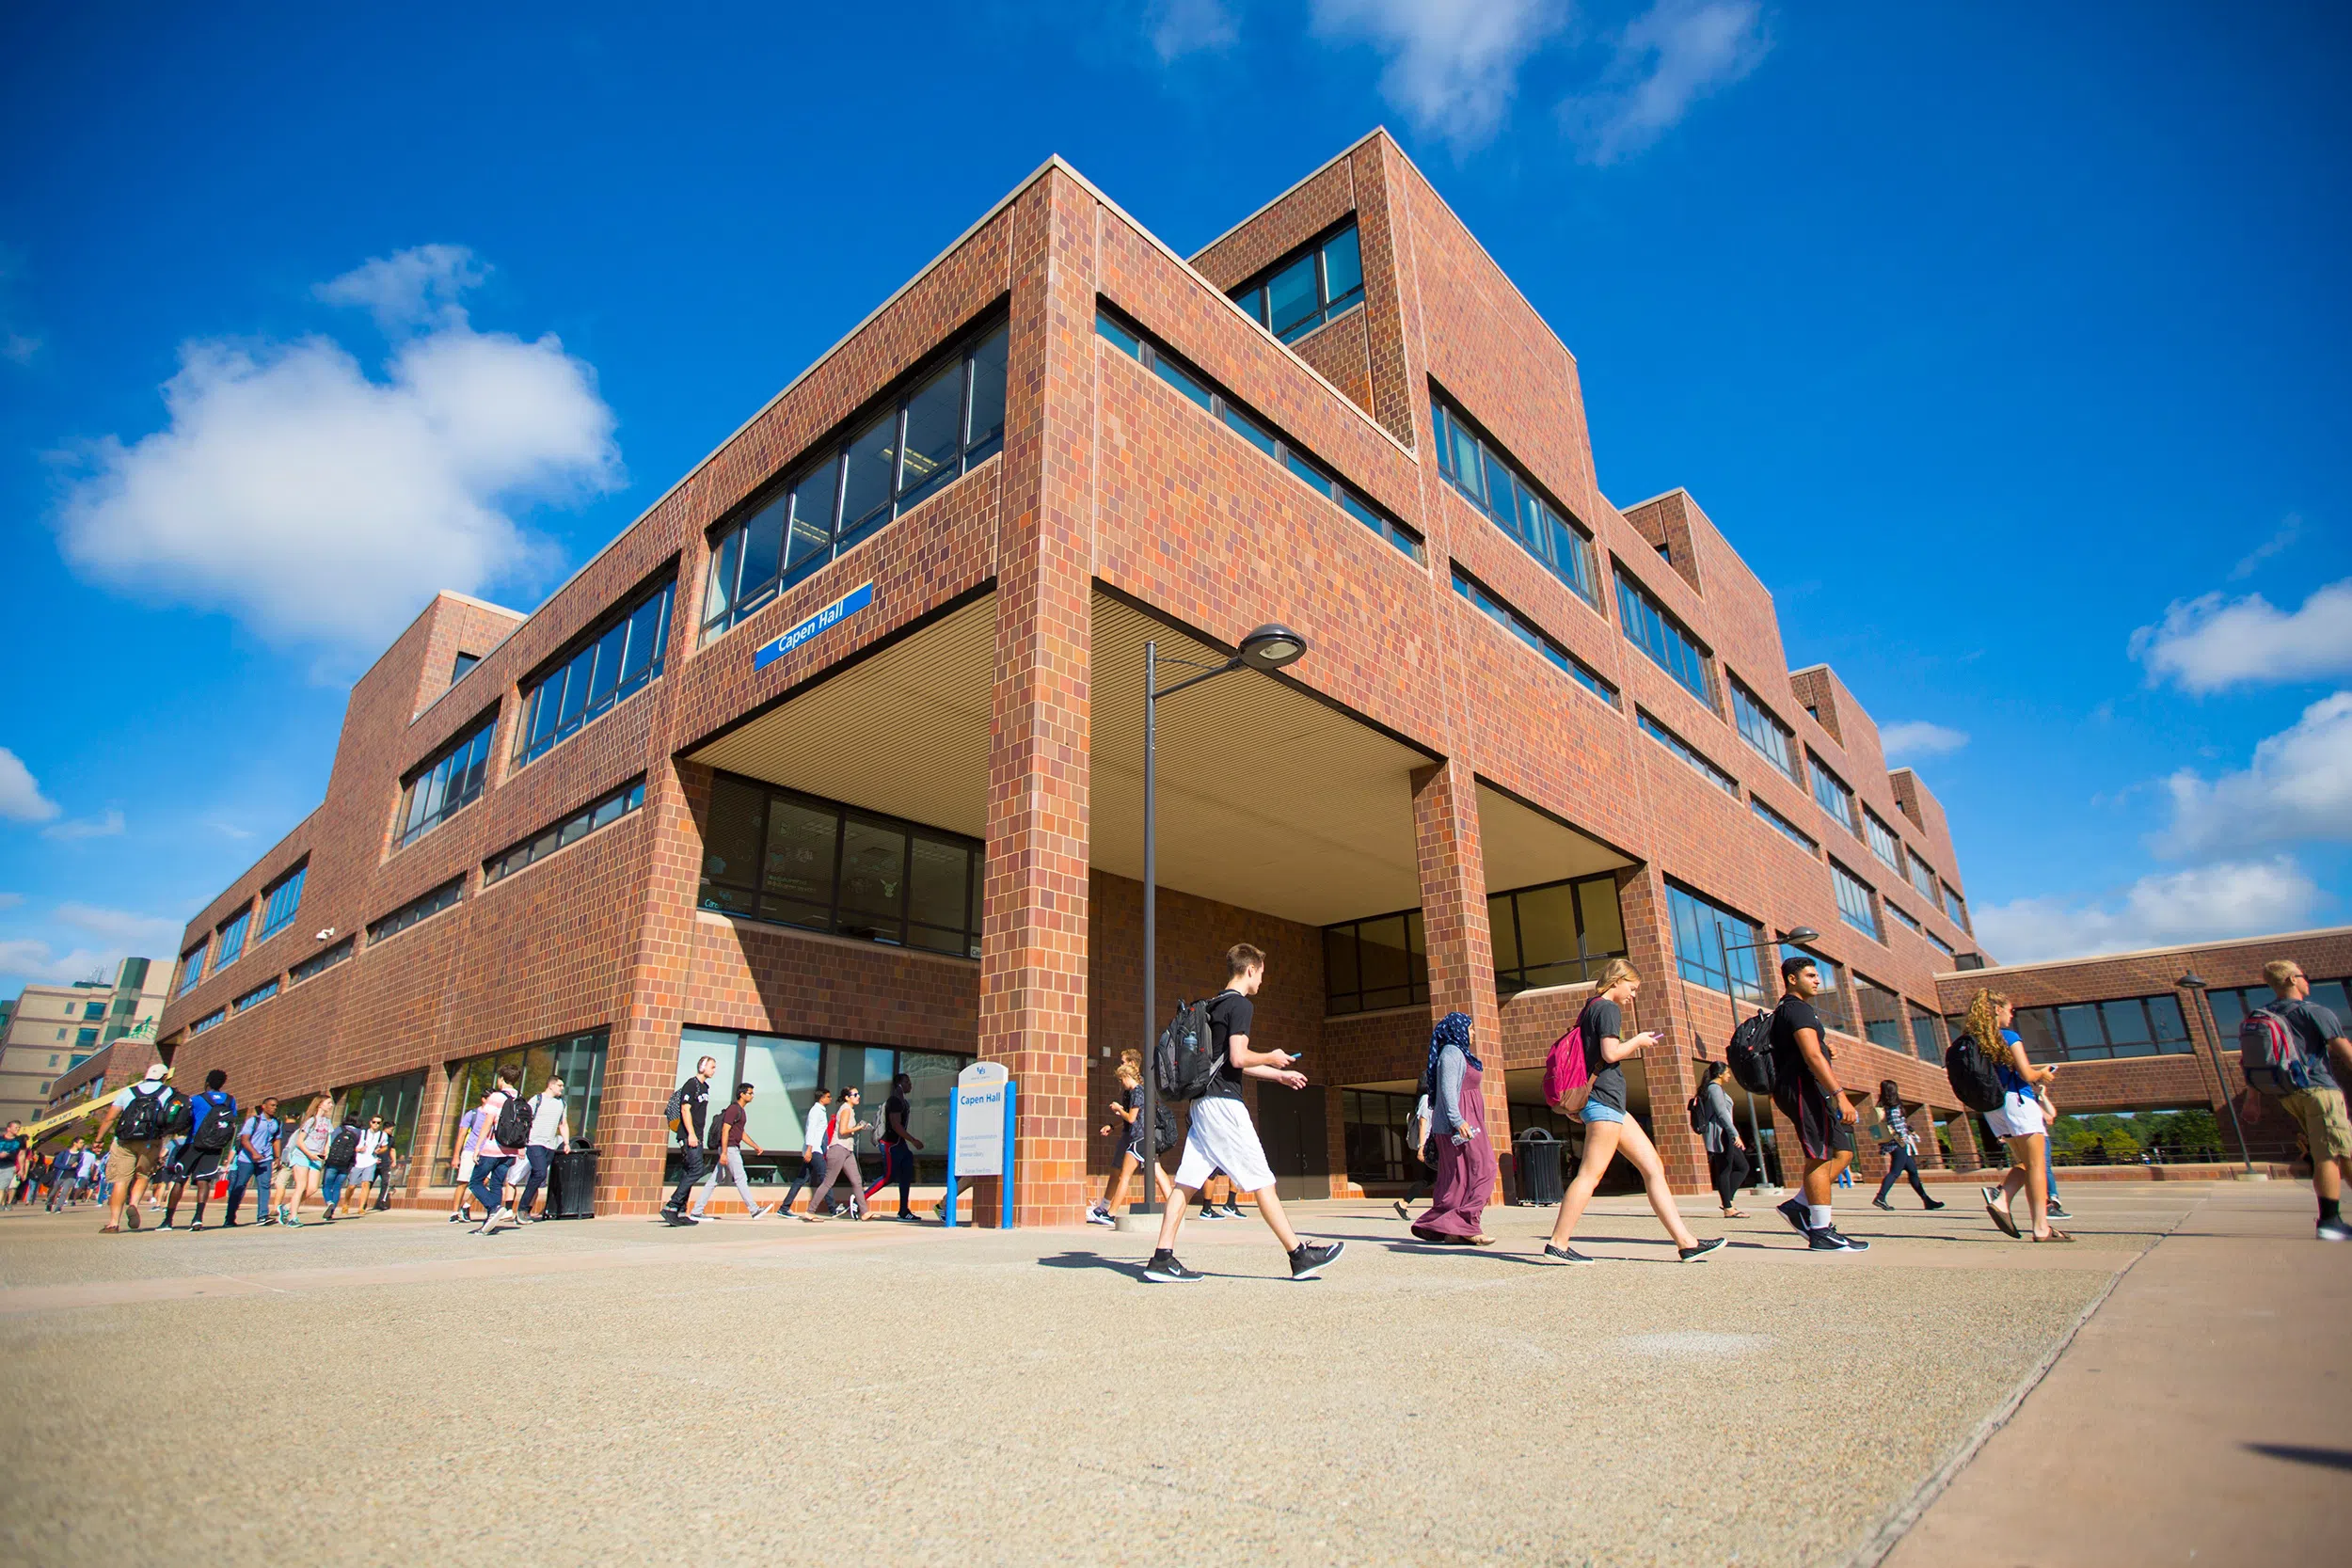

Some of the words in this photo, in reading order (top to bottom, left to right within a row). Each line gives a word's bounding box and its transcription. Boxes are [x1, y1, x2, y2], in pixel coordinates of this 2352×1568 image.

[779, 623, 815, 652] Capen
[819, 599, 843, 628] Hall
[961, 1095, 984, 1106] Capen
[986, 1092, 1000, 1102] Hall
